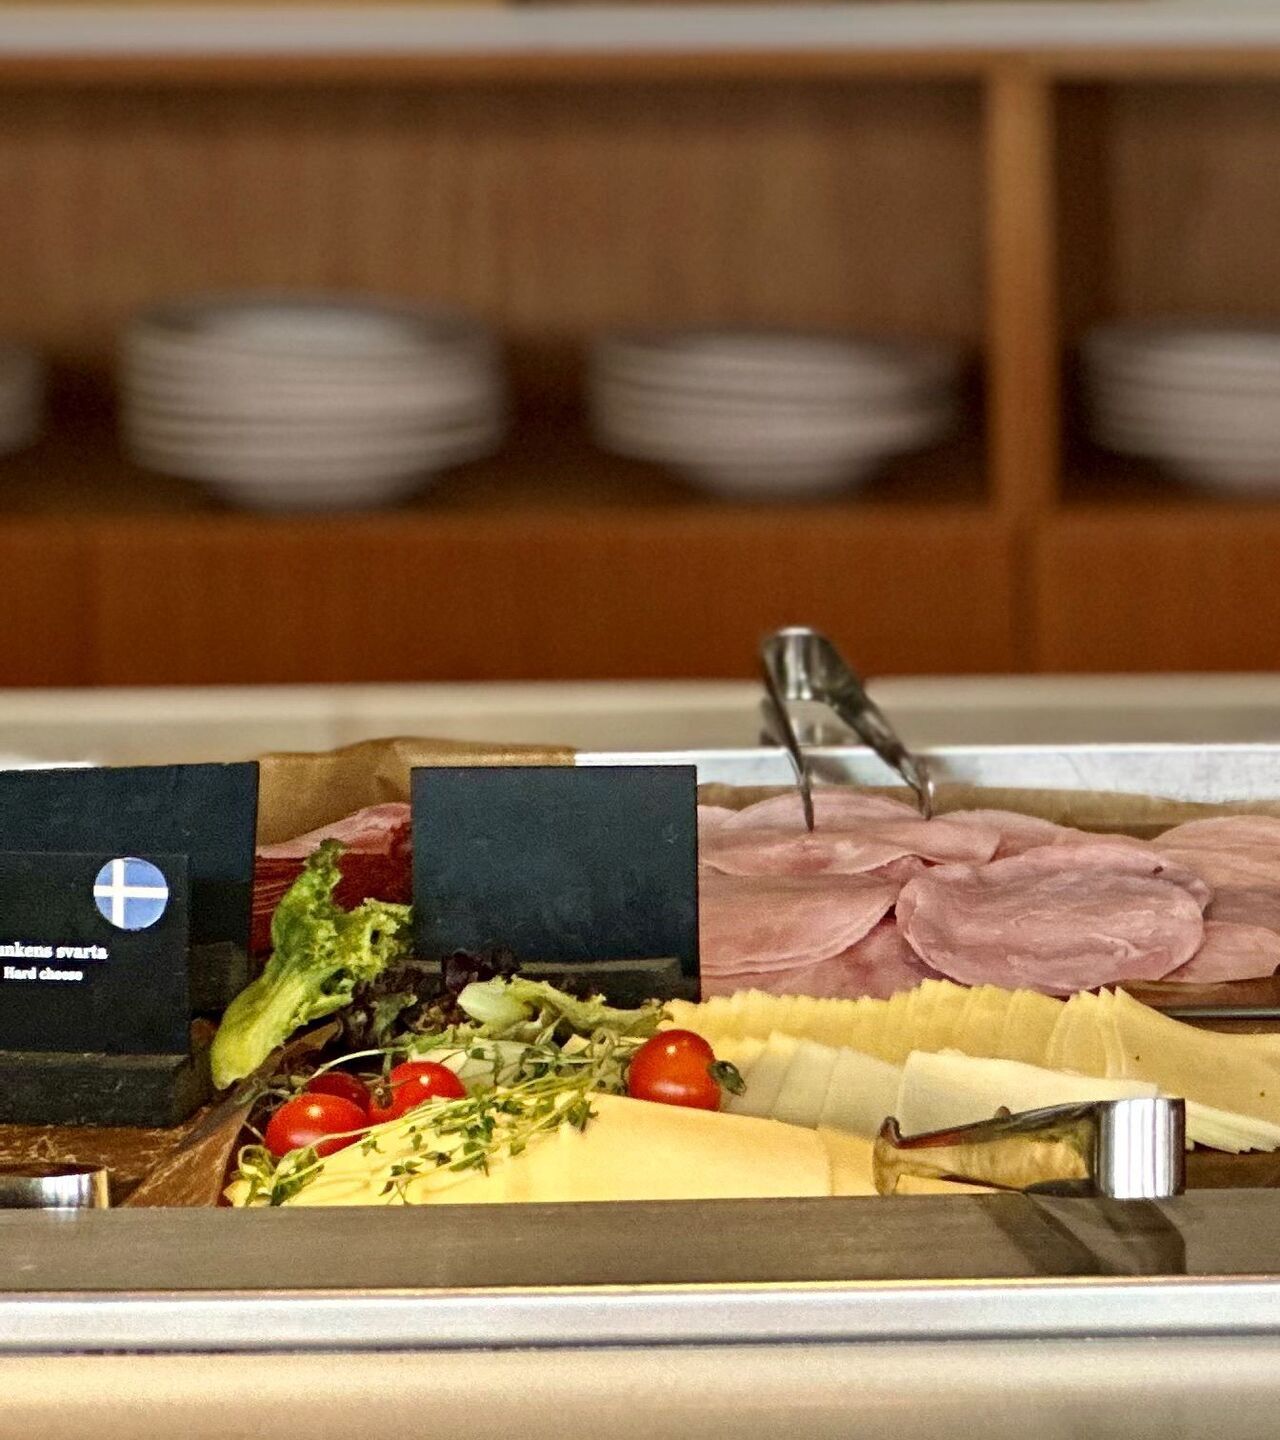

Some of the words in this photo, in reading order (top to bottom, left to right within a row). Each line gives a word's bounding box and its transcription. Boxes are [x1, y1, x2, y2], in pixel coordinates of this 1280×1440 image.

[55, 944, 108, 960] svarta
[3, 966, 37, 979] Hard
[38, 966, 83, 981] cheese
